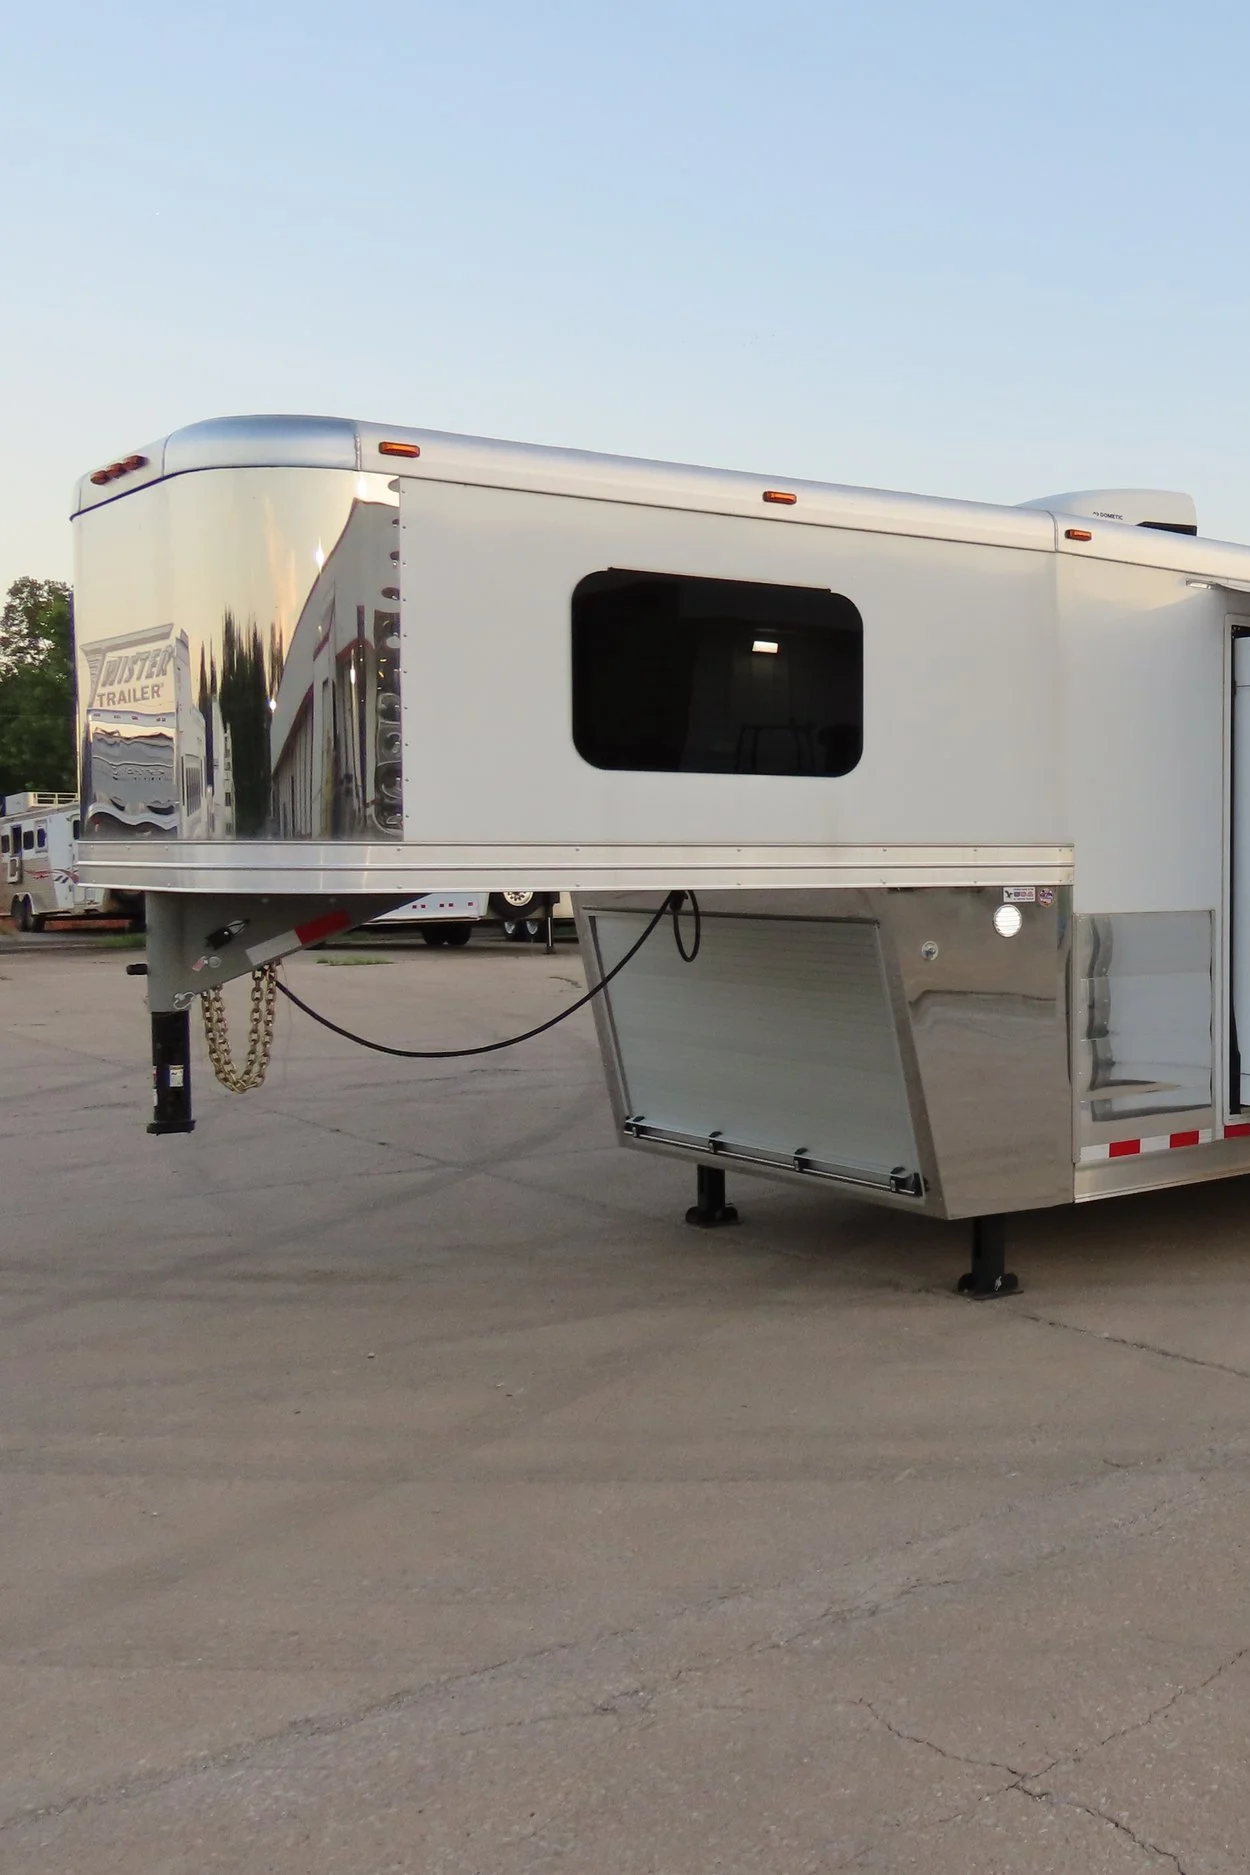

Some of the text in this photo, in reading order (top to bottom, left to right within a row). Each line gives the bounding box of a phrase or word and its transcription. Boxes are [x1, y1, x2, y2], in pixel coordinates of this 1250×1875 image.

[1099, 511, 1124, 521] DOMETIC
[79, 623, 175, 709] TWISTER
[97, 683, 162, 708] TRAILER
